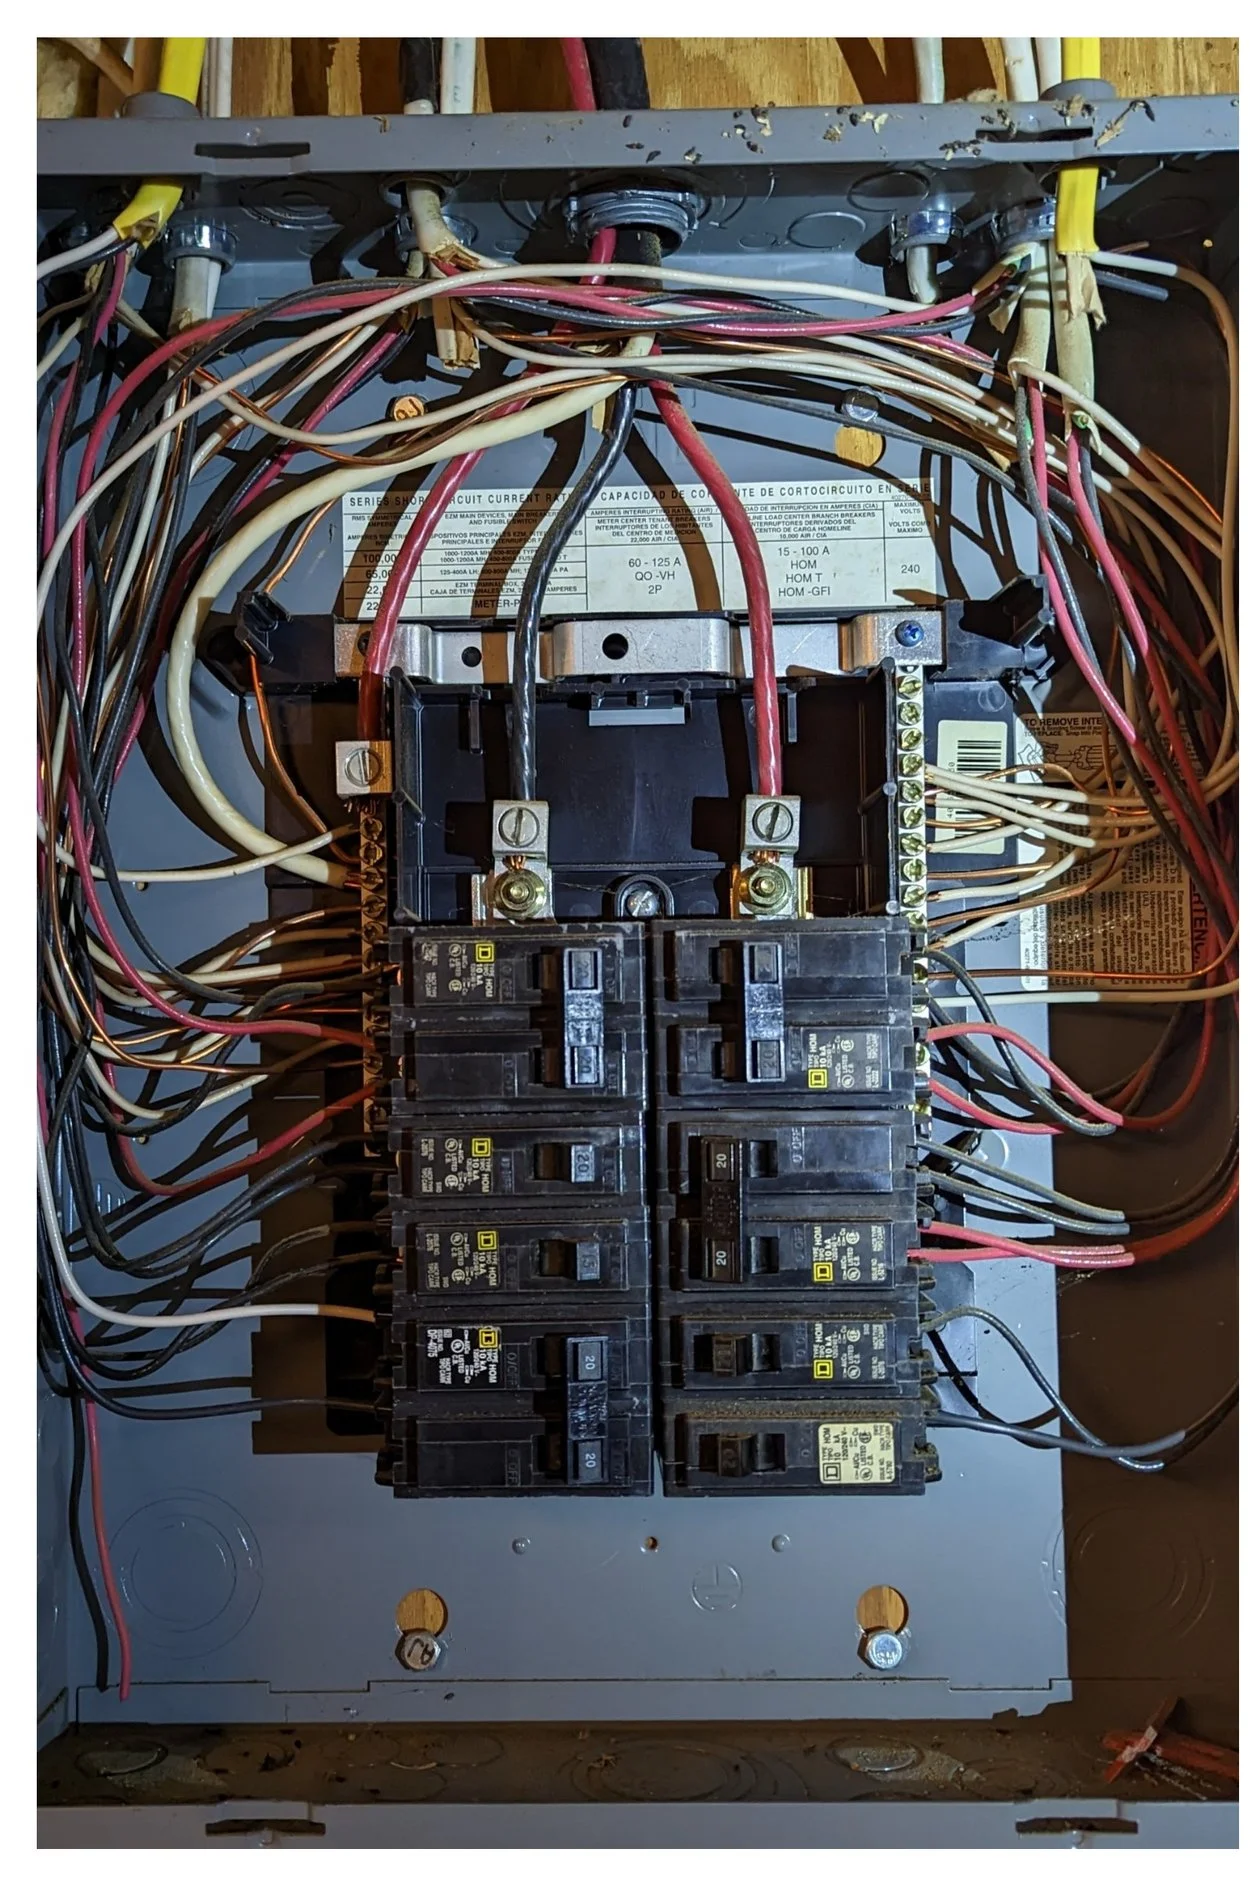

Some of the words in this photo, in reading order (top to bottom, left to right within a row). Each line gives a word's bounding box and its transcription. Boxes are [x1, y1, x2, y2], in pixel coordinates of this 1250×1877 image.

[600, 490, 666, 501] CAPACIDAD
[671, 489, 685, 499] DE
[760, 488, 774, 497] DE
[780, 485, 872, 497] CORTOCIRCUITO
[878, 484, 892, 494] EN
[350, 496, 394, 507] SERIES
[395, 495, 424, 506] SHOR
[488, 493, 539, 504] CURRENT
[863, 503, 878, 511] (CIA)
[778, 547, 790, 556] 15
[801, 546, 819, 555] 100
[822, 545, 830, 555] A
[628, 558, 641, 568] 60
[652, 557, 670, 567] 125
[673, 557, 682, 566] A
[790, 560, 817, 569] HOM
[901, 564, 920, 574] 240
[635, 571, 652, 582] QO
[656, 570, 676, 580] -VH
[786, 574, 812, 583] HOM
[816, 573, 823, 582] T
[648, 585, 662, 594] 2P
[778, 587, 804, 597] HOM
[808, 586, 831, 596] -GFI
[1024, 718, 1037, 727] TO
[1040, 717, 1080, 727] REMOVE
[576, 1153, 588, 1173] 20
[716, 1153, 727, 1168] 20
[716, 1250, 727, 1265] 20
[815, 1323, 823, 1342] HOM
[427, 1329, 438, 1358] DP-4075
[825, 1348, 832, 1358] 10
[585, 1355, 596, 1370] 20
[489, 1363, 497, 1383] HOM
[823, 1427, 831, 1443] HOM
[585, 1453, 596, 1468] 20
